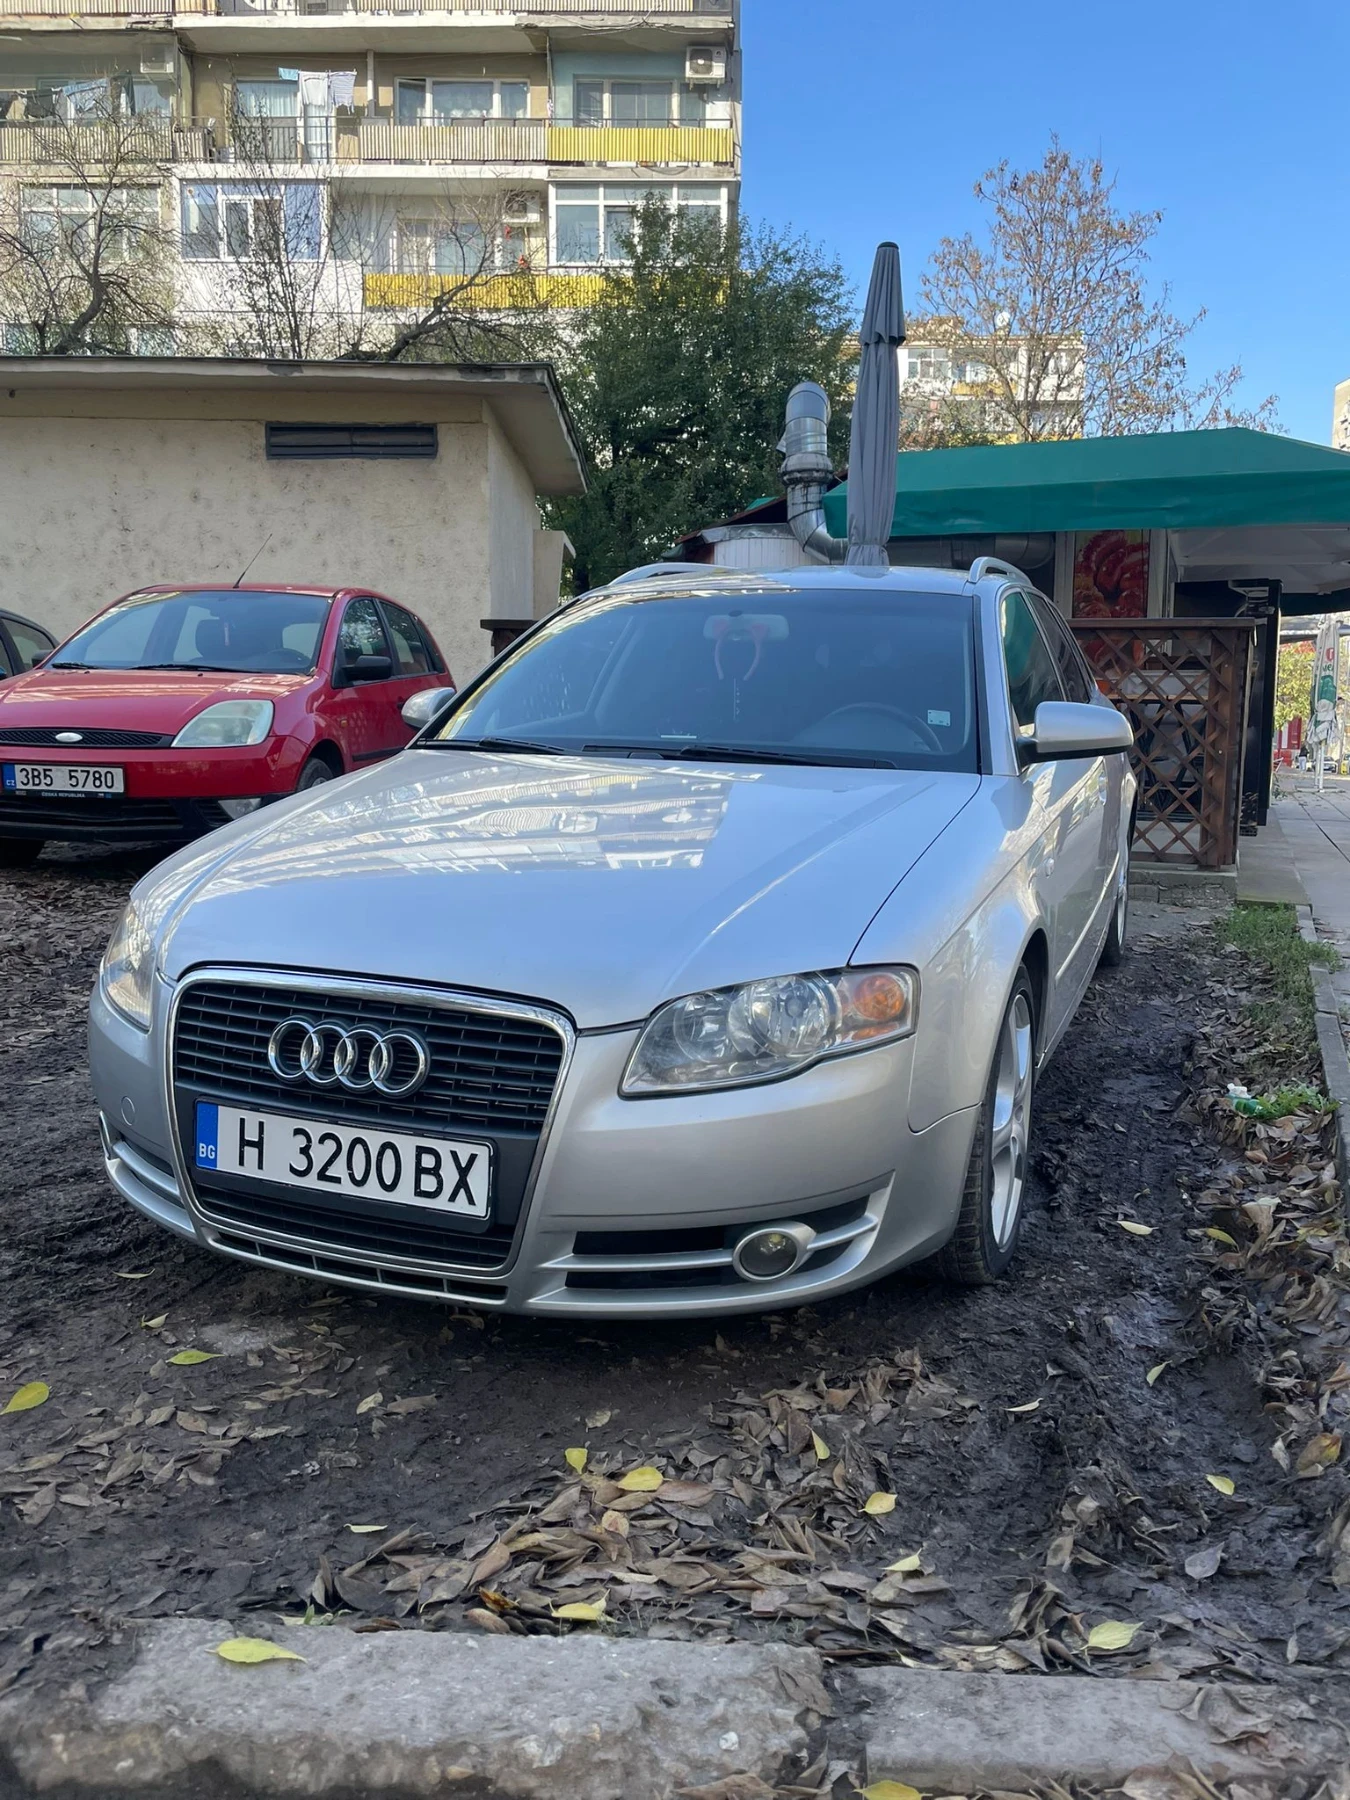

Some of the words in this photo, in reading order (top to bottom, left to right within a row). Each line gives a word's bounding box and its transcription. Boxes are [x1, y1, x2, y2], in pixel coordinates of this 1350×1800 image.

[20, 768, 53, 787] 3B5
[69, 769, 114, 789] 5780
[198, 1143, 215, 1160] BG
[239, 1117, 265, 1171] H
[289, 1127, 402, 1192] 3200
[414, 1145, 478, 1206] BX
